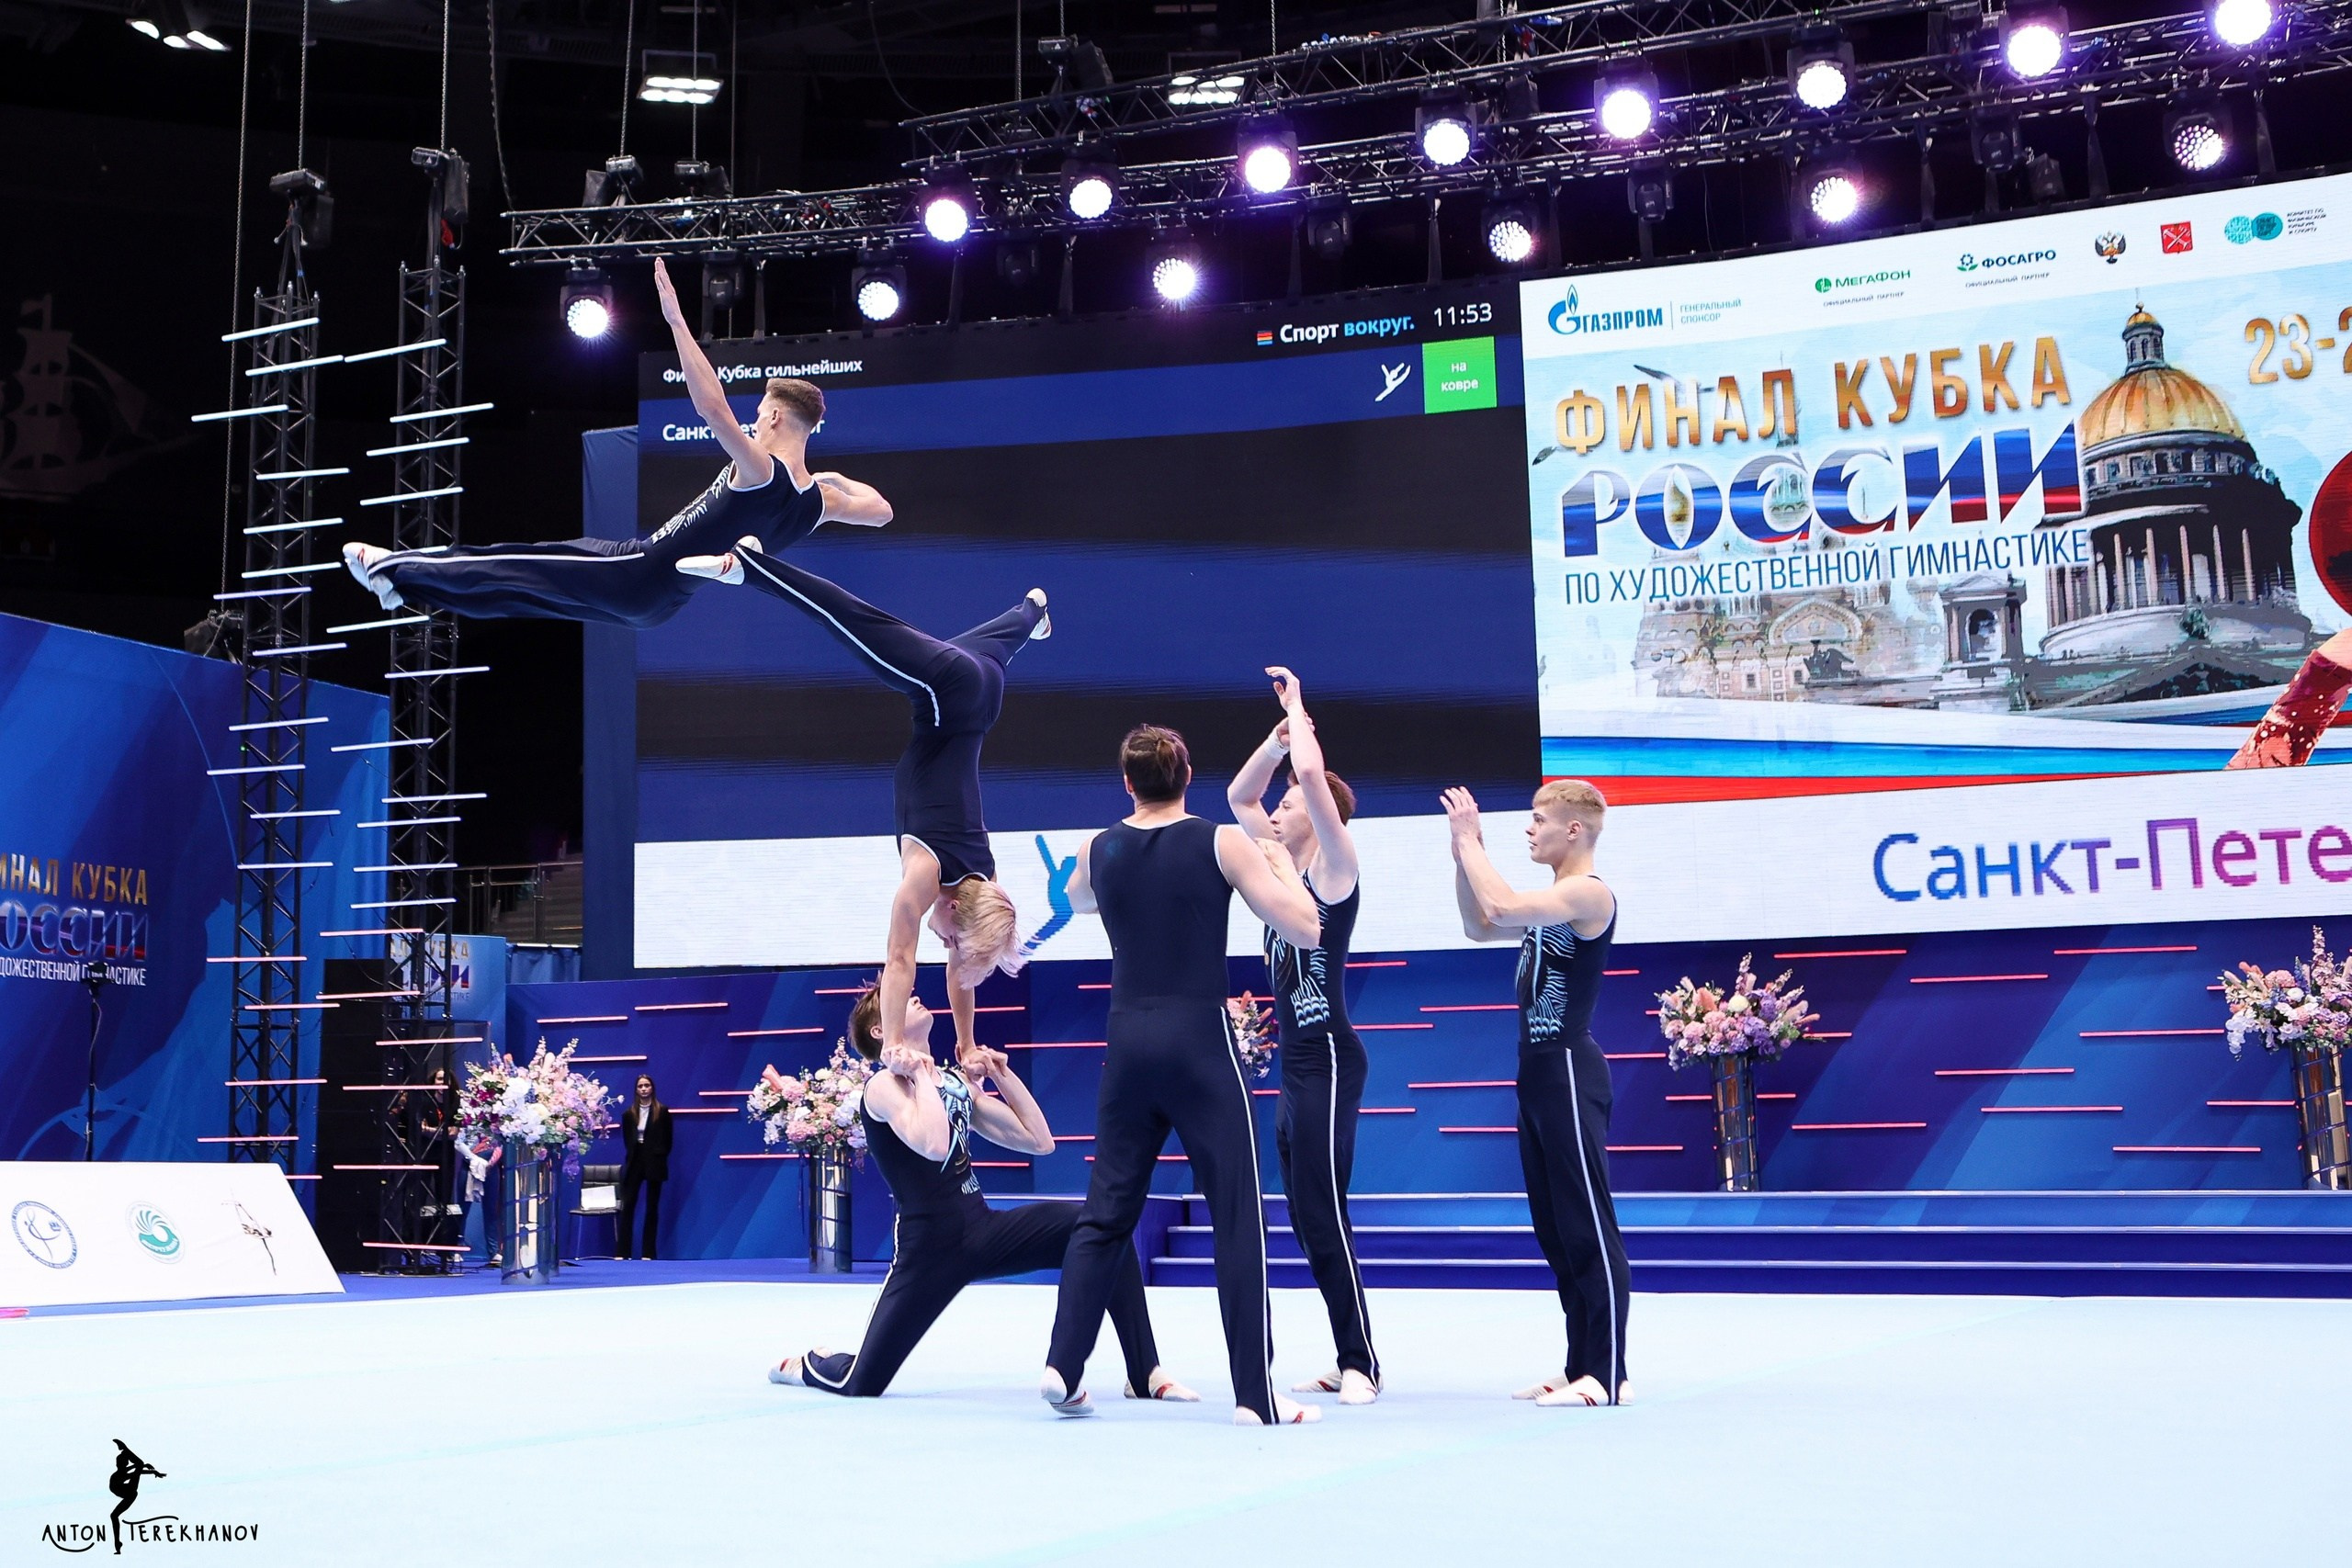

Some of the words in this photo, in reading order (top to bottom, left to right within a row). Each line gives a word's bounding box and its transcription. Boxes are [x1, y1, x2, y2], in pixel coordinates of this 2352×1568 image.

[1981, 249, 2057, 269] ФОСАГРО
[1835, 269, 1912, 288] МЕГАФОН
[1433, 302, 1493, 327] 11:53
[1679, 299, 1742, 313] ГЕНЕРАЛЬНЫЙ
[1280, 323, 1340, 344] Спорт
[1344, 316, 1415, 337] вокруг.
[1583, 307, 1664, 333] ГАЗПРОМ
[1680, 313, 1722, 325] СПОНСОР
[718, 364, 763, 383] Кубка
[764, 359, 864, 378] сильнейших
[1451, 361, 1468, 372] на
[1441, 378, 1479, 393] ковре
[1555, 367, 1800, 454] ФИНАЛ
[1834, 336, 2073, 430] КУБКА
[1561, 418, 2083, 558] РОССИИ
[1566, 571, 1600, 604] ПО
[1610, 541, 1881, 603] ХУДОЖЕСТВЕННОЙ
[1889, 528, 2090, 580] ГИМНАСТИКЕ
[1873, 818, 2352, 902] Санкт-Пете
[71, 861, 148, 906] КУБКА
